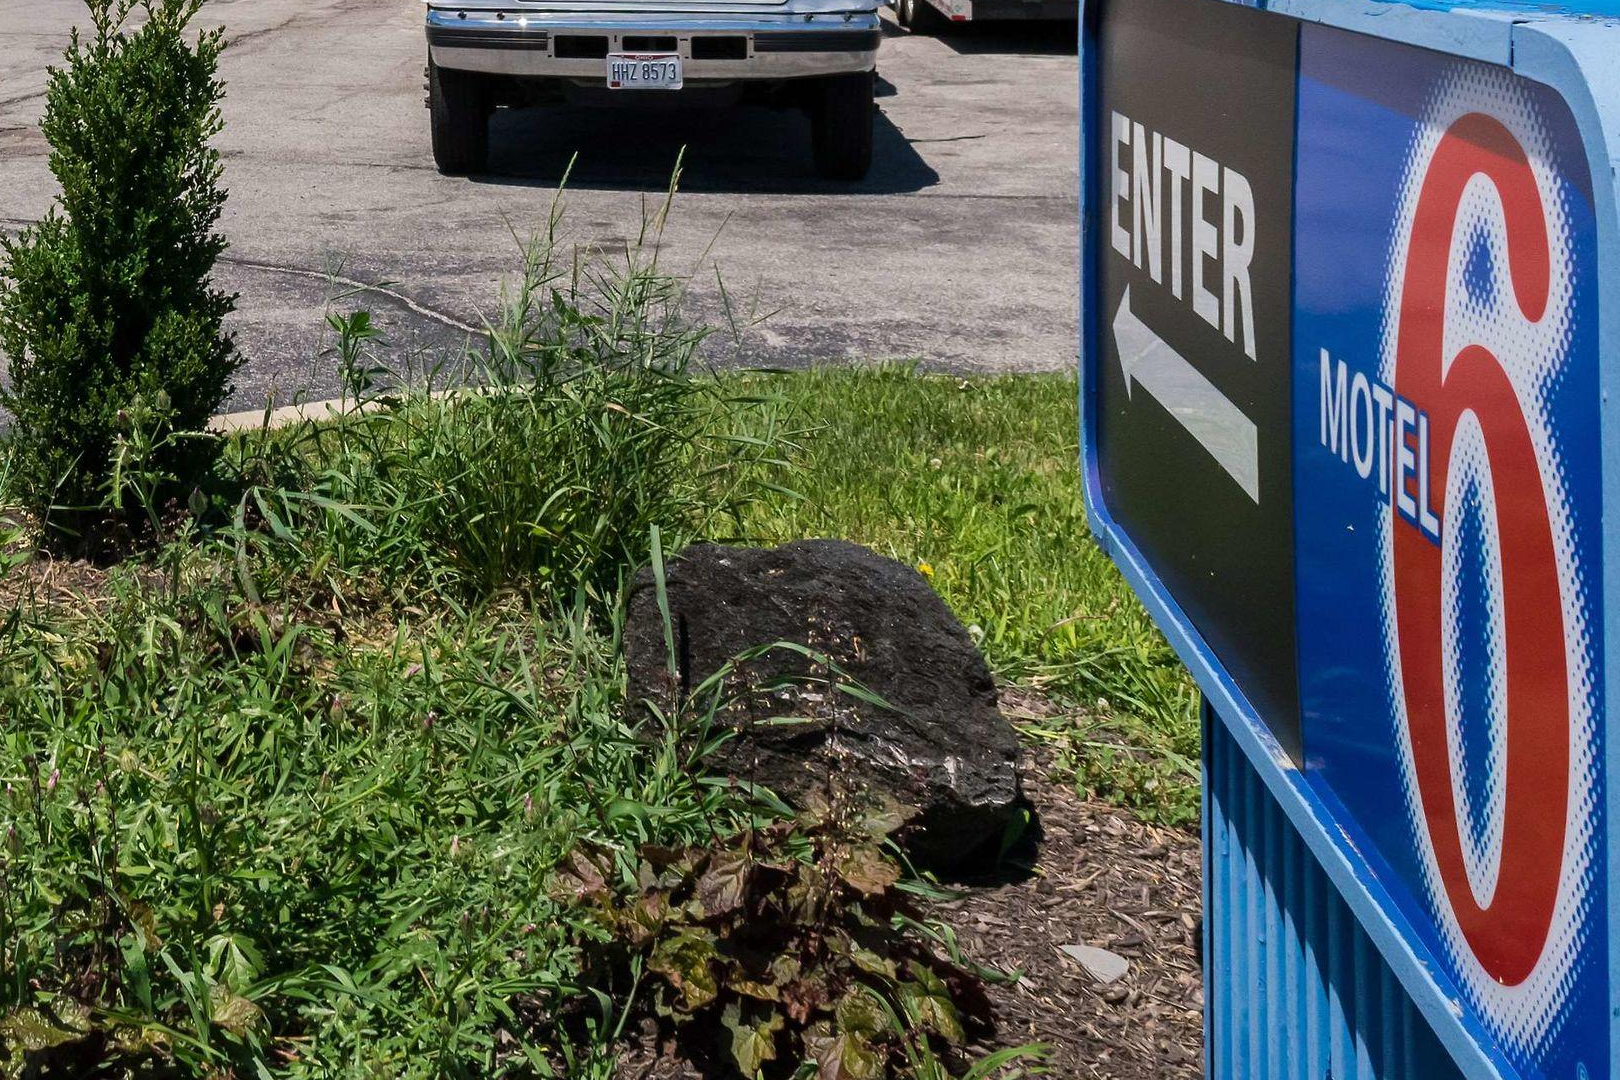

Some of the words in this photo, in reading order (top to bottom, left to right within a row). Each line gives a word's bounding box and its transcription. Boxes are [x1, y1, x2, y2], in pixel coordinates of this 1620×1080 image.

[612, 63, 638, 80] HHZ
[642, 63, 677, 80] 8573
[1111, 110, 1257, 362] ENTER
[1320, 347, 1439, 537] MOTEL
[1393, 112, 1570, 987] 6
